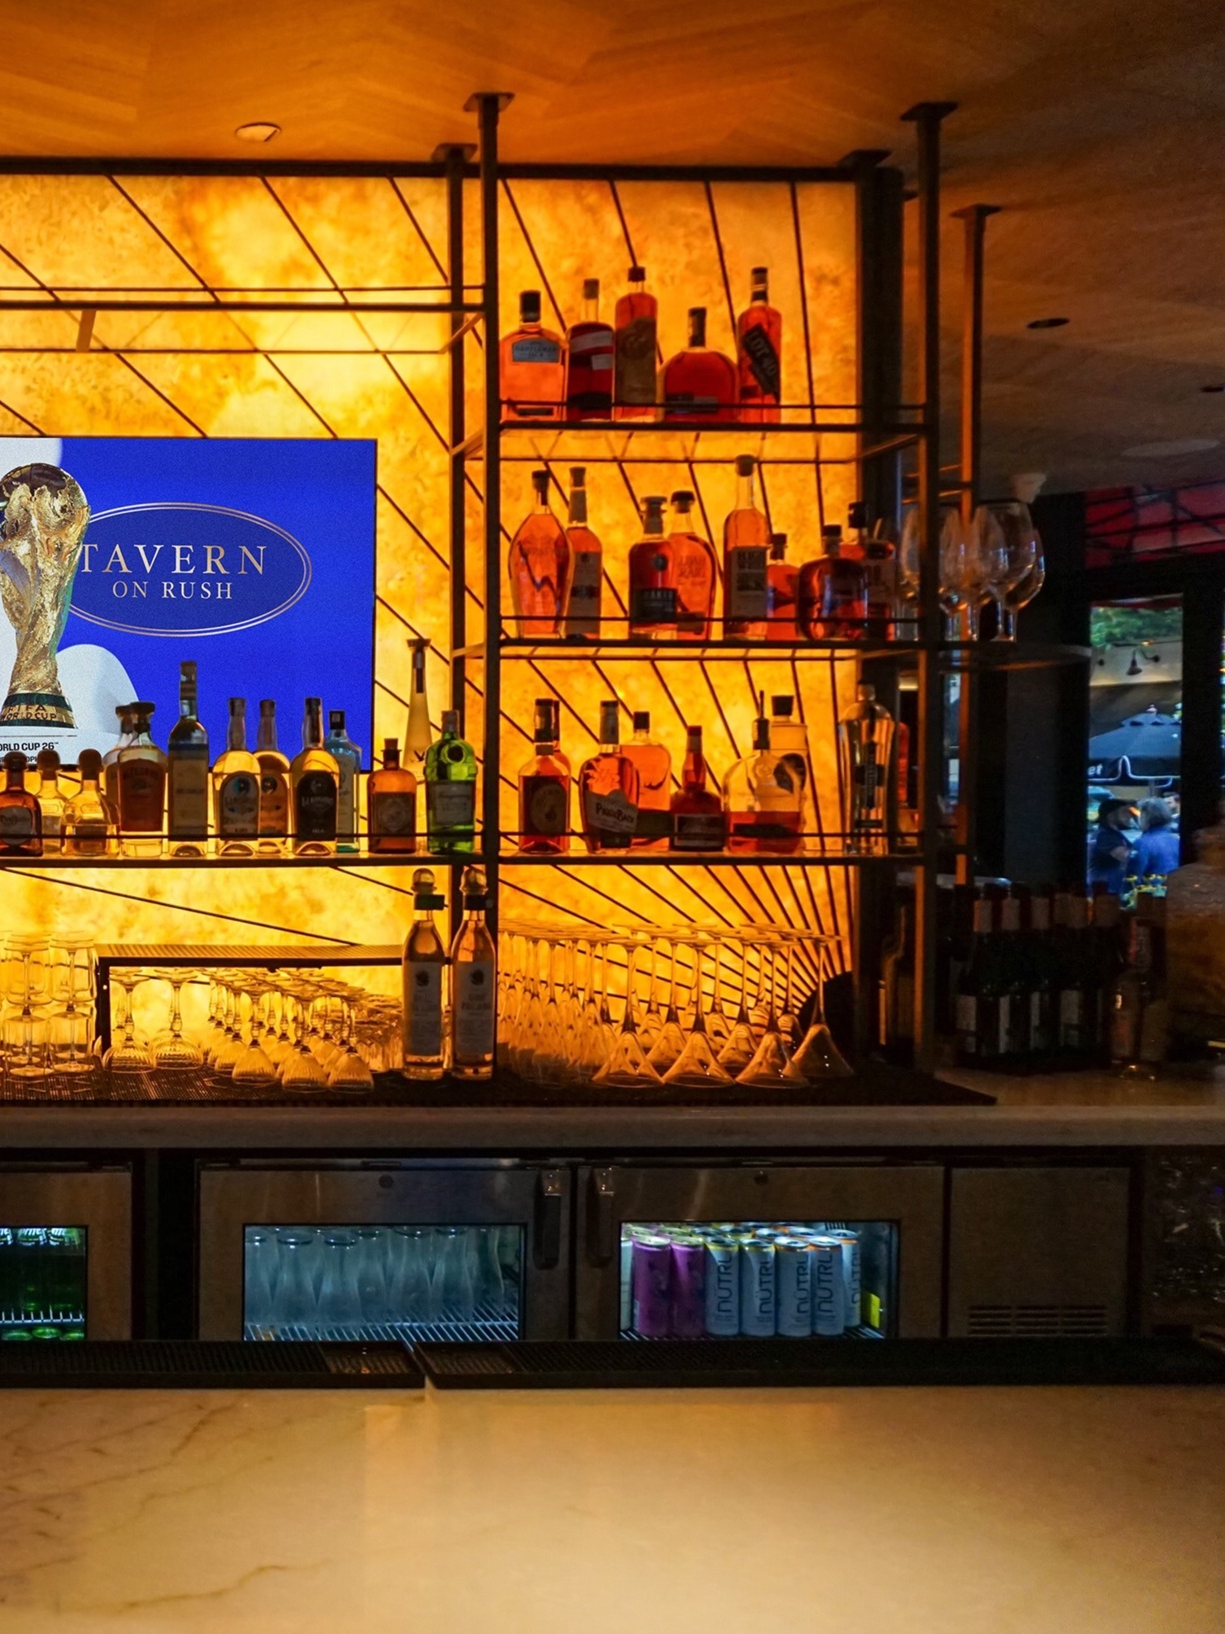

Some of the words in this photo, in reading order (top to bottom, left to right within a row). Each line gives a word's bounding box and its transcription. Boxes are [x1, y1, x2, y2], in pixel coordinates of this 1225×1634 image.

[81, 543, 267, 575] TAVERN
[111, 580, 148, 598] ON
[161, 581, 233, 600] RUSH
[21, 742, 41, 751] CUP
